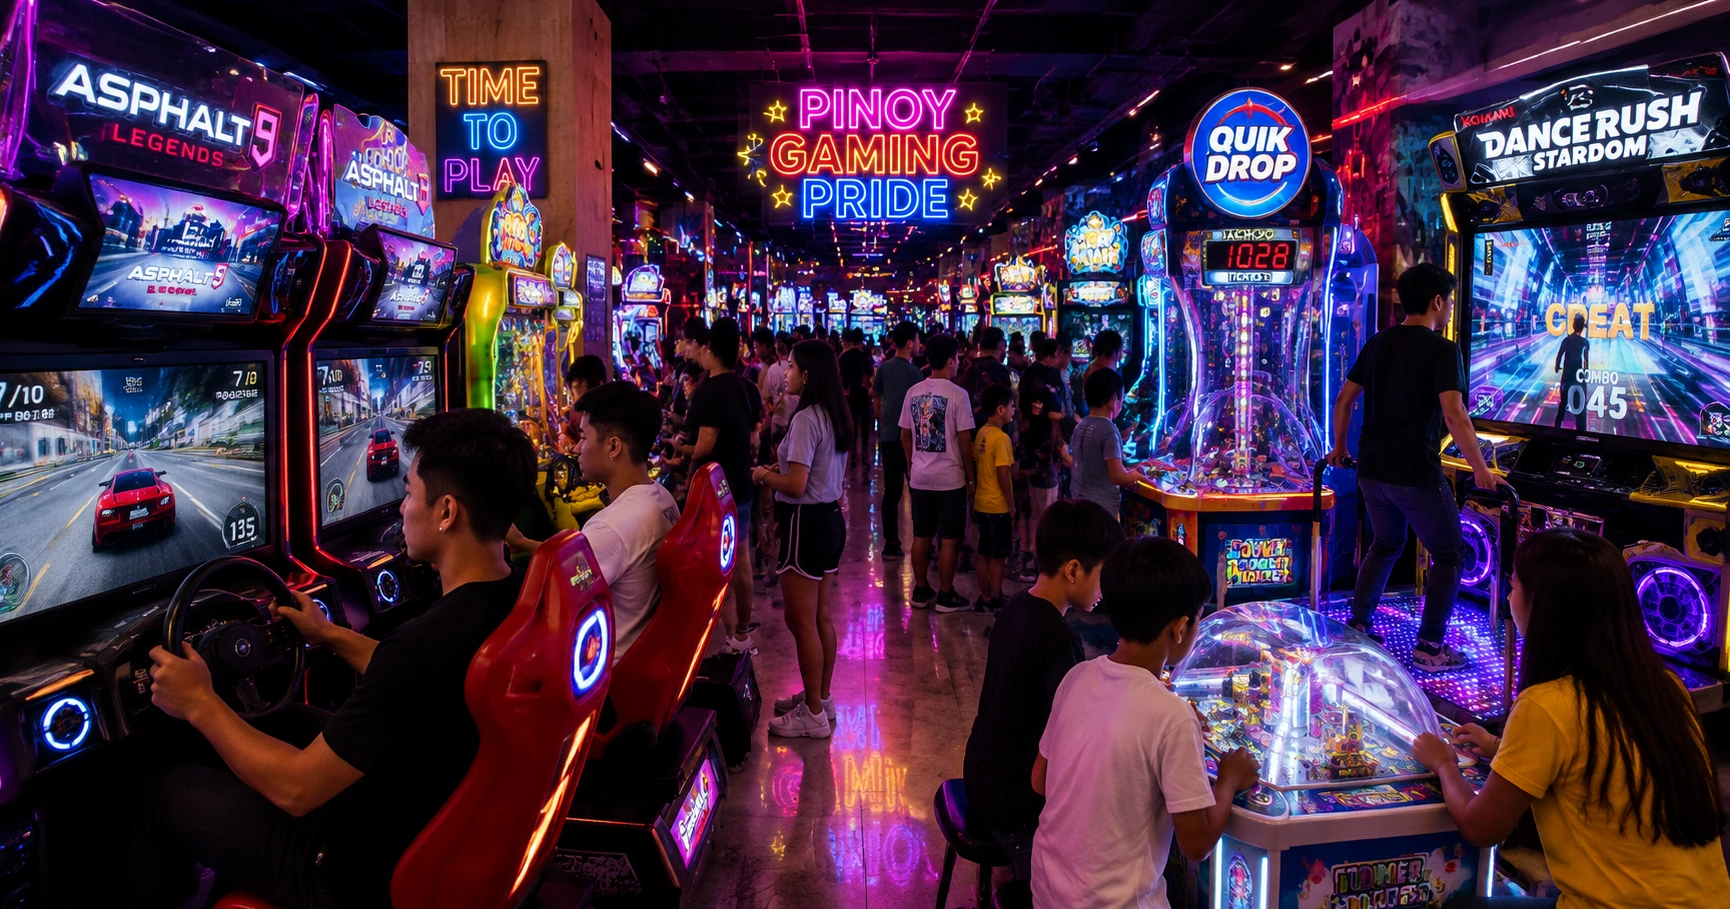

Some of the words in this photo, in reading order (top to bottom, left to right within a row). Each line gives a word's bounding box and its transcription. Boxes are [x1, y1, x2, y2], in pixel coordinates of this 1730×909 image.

[440, 66, 540, 106] TIME
[56, 64, 252, 147] ASPHALT
[250, 104, 283, 171] 9
[800, 88, 956, 130] PINOY
[1476, 113, 1591, 159] DANCE
[1594, 91, 1702, 140] RUSH
[113, 127, 224, 167] LEGENDS
[463, 112, 517, 150] TO
[1208, 125, 1294, 154] QUIK
[770, 133, 979, 175] GAMING
[1204, 153, 1297, 182] DROP
[1533, 135, 1649, 171] STARDOM
[344, 159, 420, 203] ASPHALT
[444, 156, 541, 193] PLAY
[803, 178, 949, 218] PRIDE
[1227, 243, 1290, 269] 1028
[127, 265, 215, 286] ASPHALT
[1575, 368, 1619, 385] COMBO
[1566, 385, 1628, 420] 045
[230, 516, 255, 541] 135
